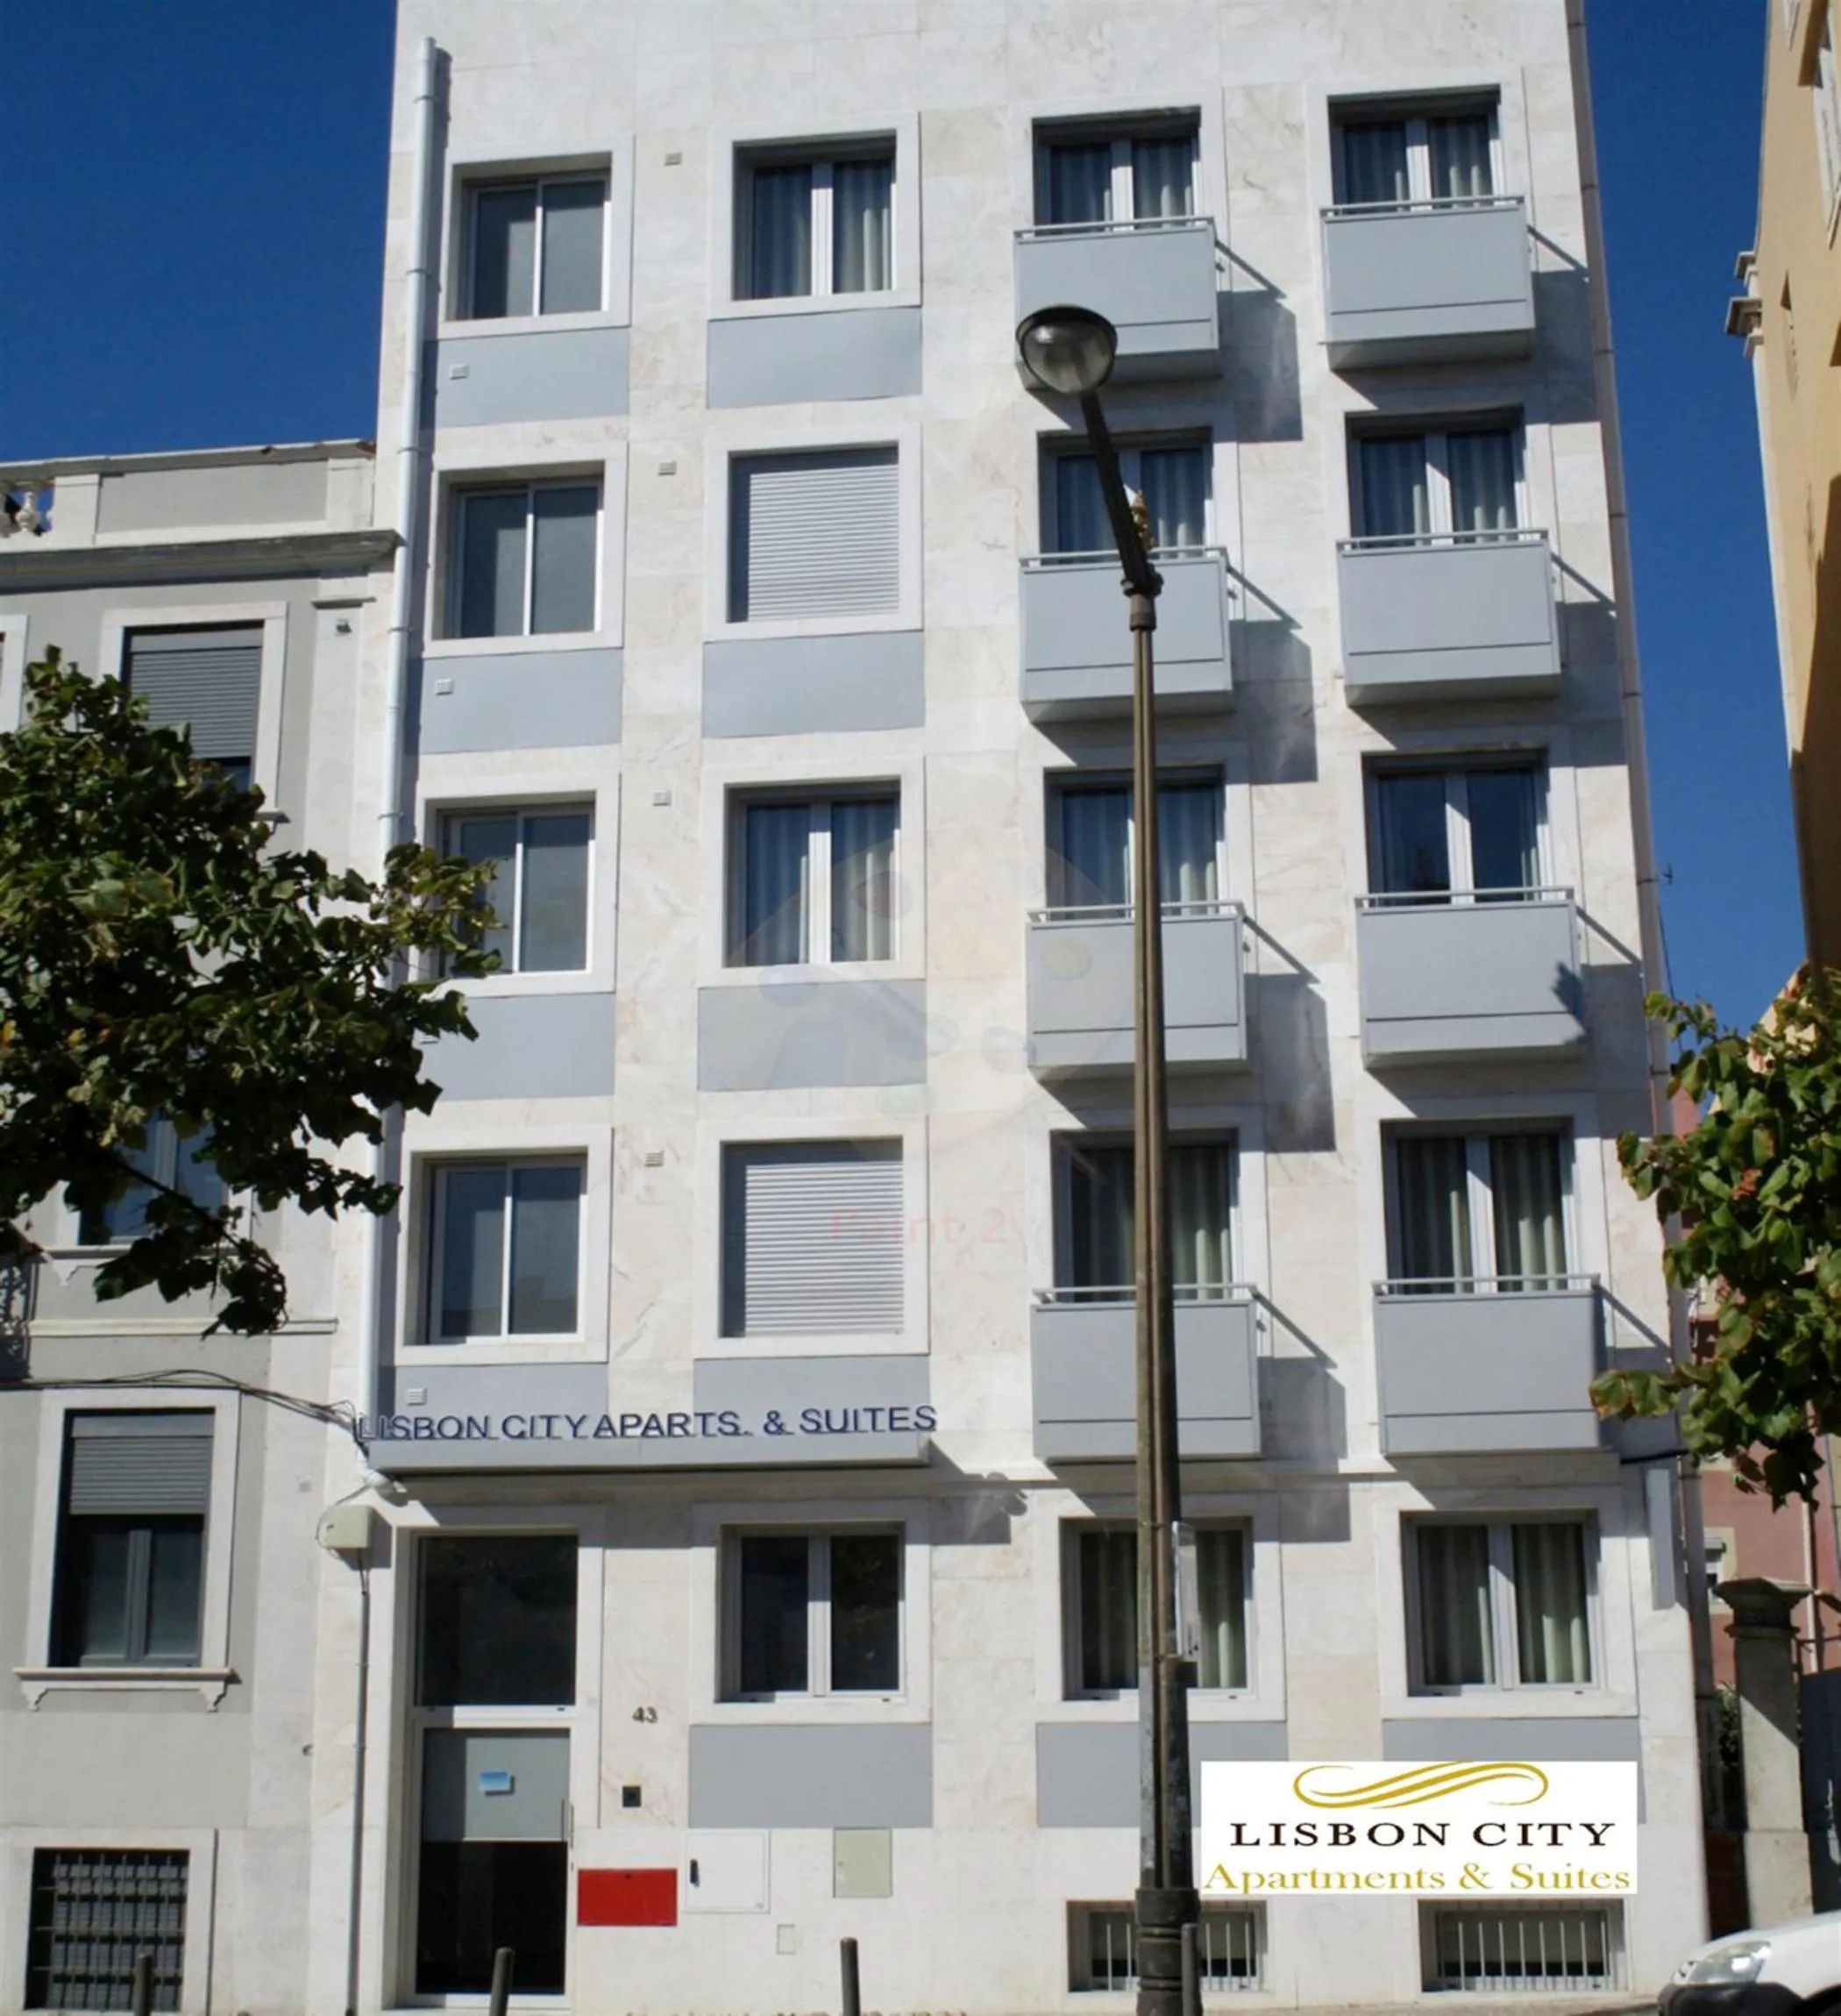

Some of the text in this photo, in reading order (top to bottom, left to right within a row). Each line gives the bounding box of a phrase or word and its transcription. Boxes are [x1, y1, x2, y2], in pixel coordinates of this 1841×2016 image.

[357, 1406, 938, 1441] LISBON CITY APARTS. & SUITES
[632, 1706, 658, 1724] 43
